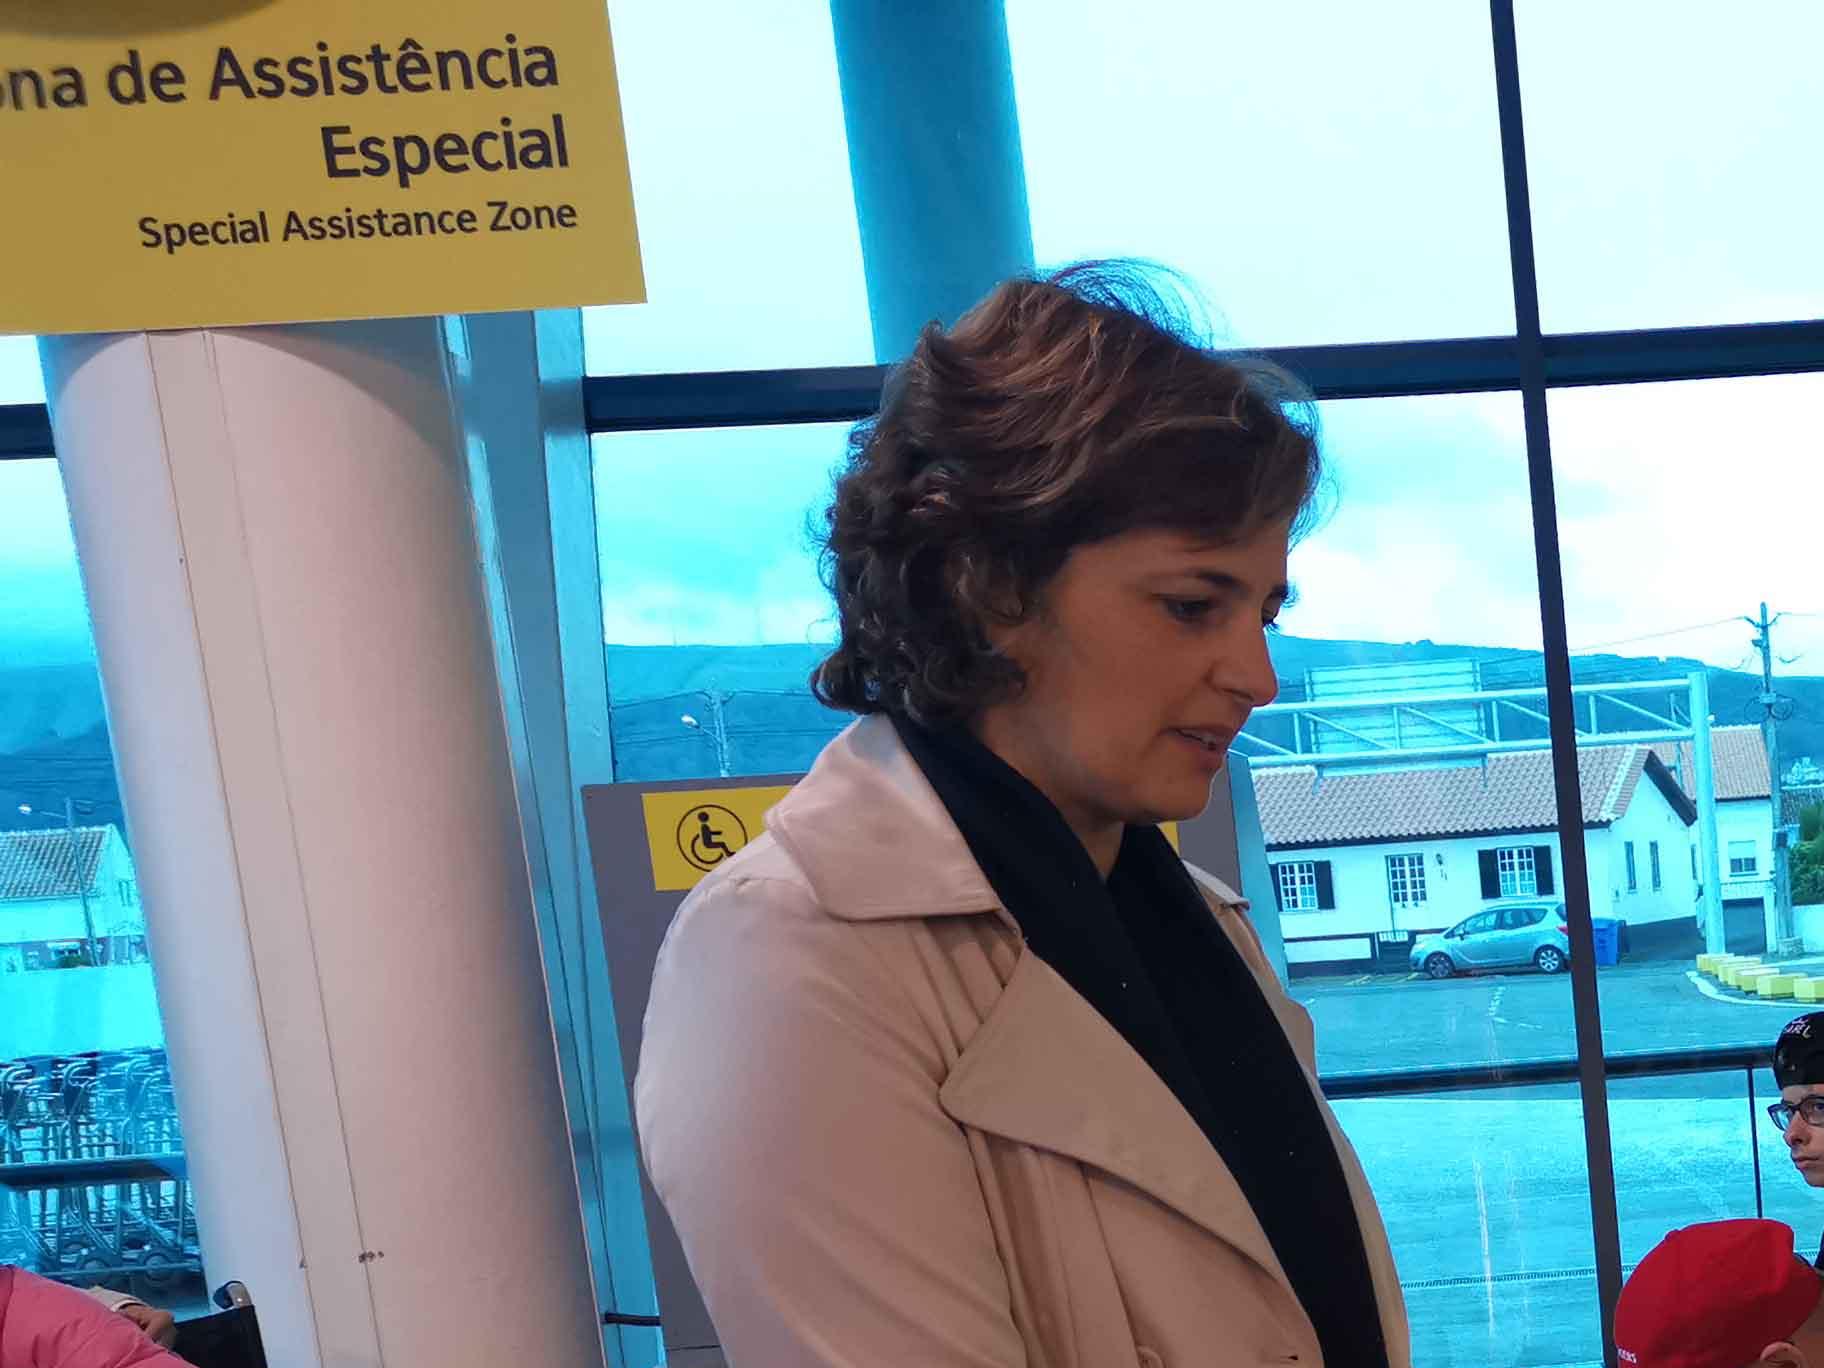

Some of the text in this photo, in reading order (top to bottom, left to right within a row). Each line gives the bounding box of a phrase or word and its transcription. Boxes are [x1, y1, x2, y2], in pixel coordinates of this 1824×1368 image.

[0, 33, 559, 111] na de Assistência
[320, 113, 569, 188] Especial
[138, 200, 578, 255] Special Assistance Zone
